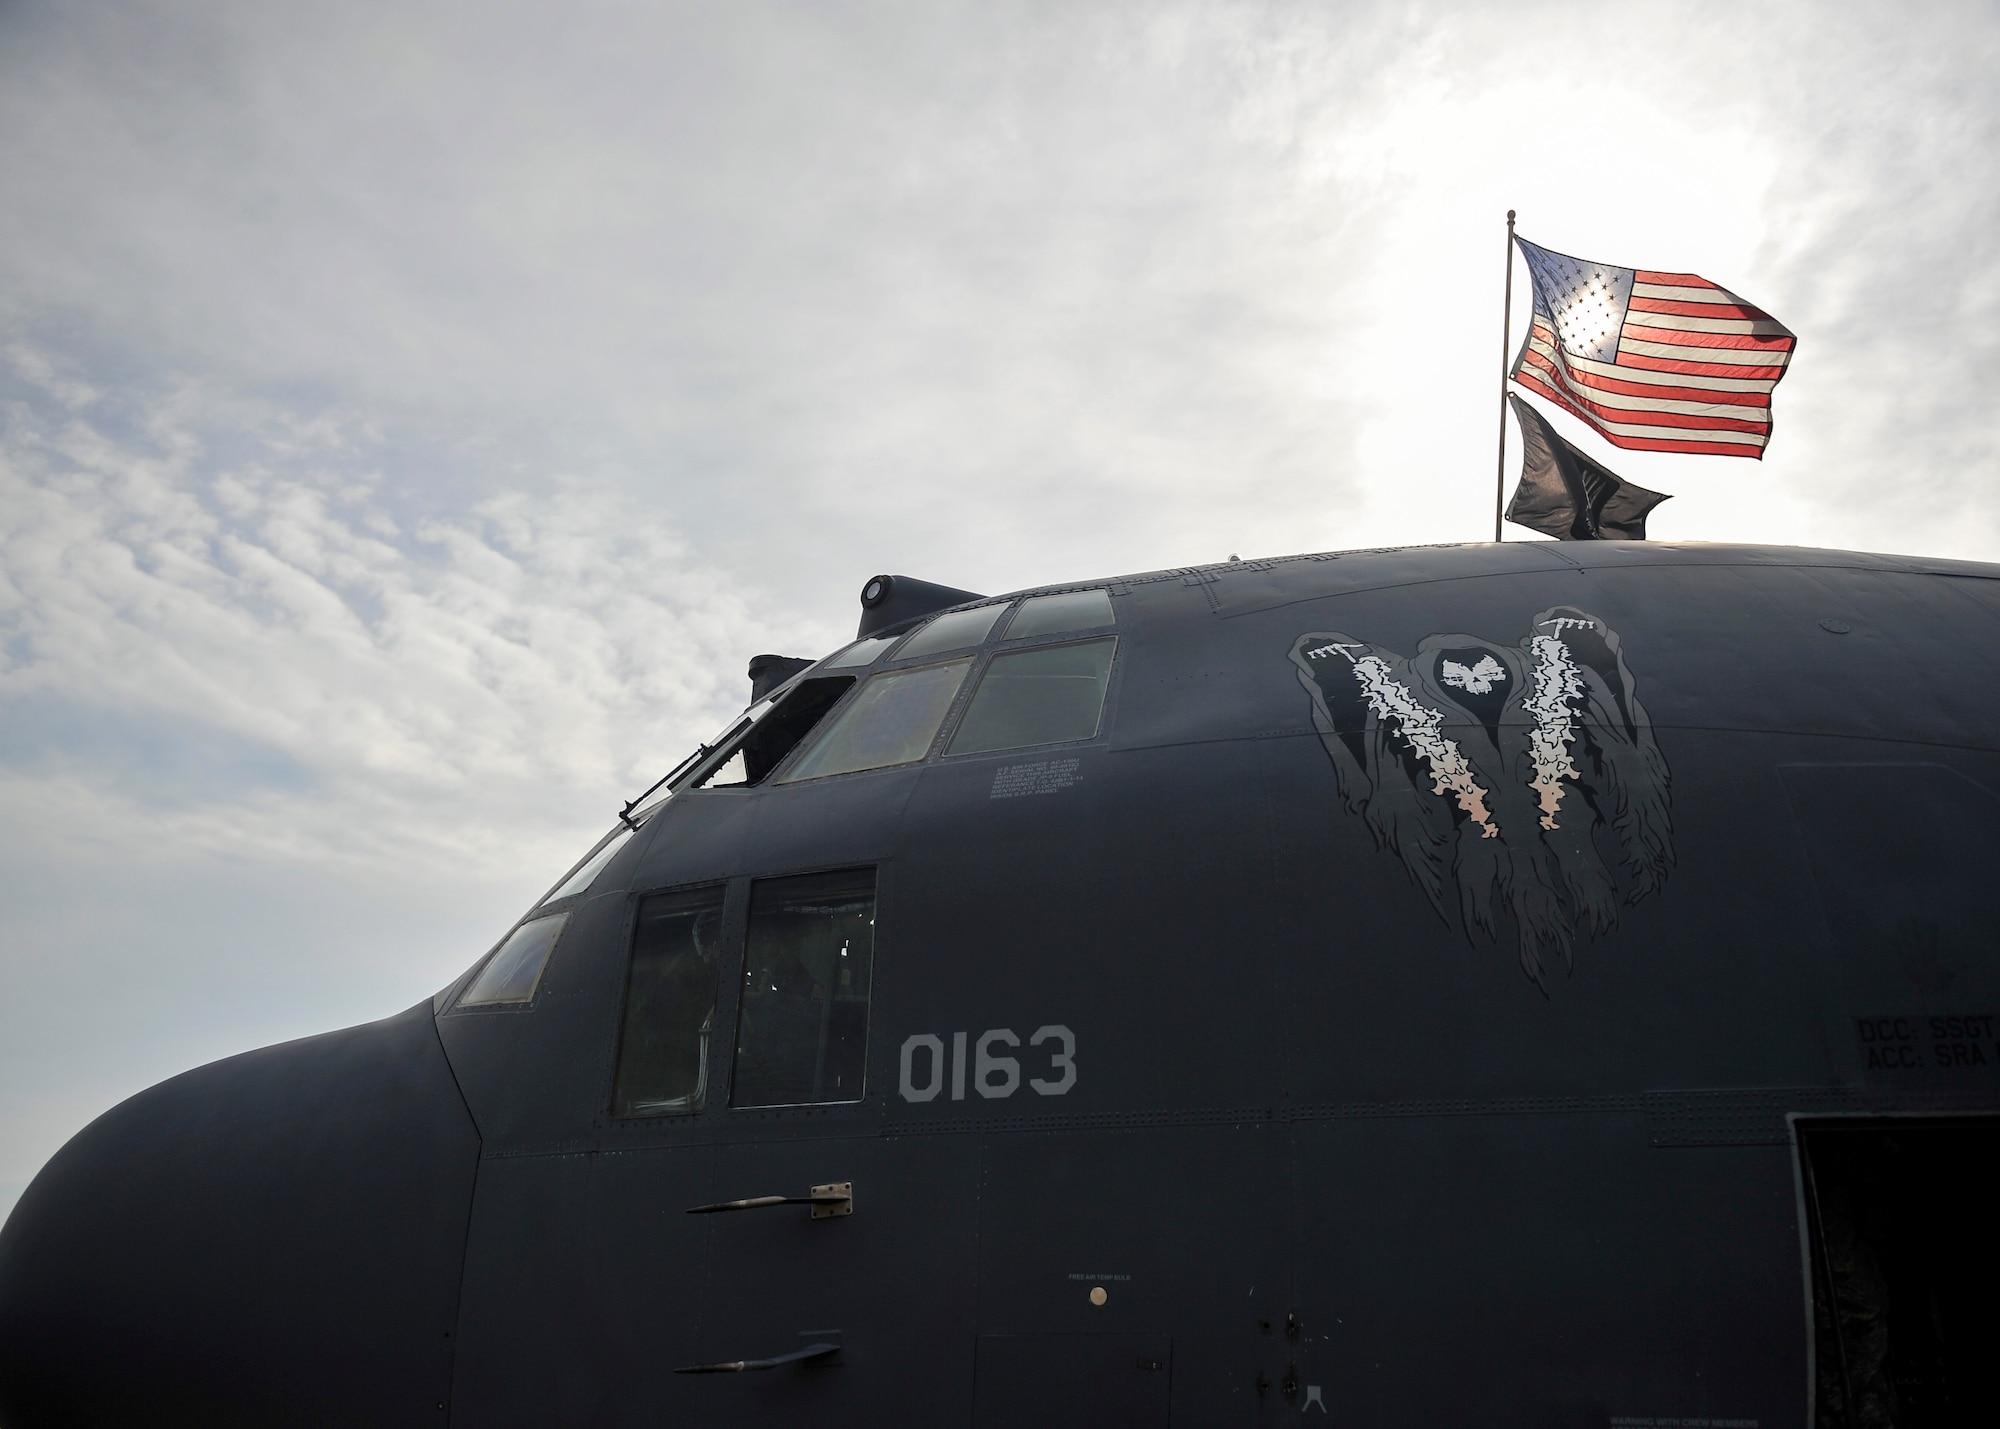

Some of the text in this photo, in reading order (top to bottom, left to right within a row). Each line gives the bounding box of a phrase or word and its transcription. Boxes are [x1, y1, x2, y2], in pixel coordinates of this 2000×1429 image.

[1024, 761, 1048, 769] FORCE
[991, 781, 1074, 794] IDENTIPLATE LOCATION
[1858, 1015, 1992, 1042] DCC: SSGT
[1868, 1045, 1923, 1069] ACC:
[1935, 1042, 1987, 1067] SRA
[899, 1024, 1077, 1103] 0163
[1068, 1273, 1085, 1281] FREE
[1096, 1273, 1113, 1281] TEMP
[1609, 1416, 1654, 1425] WARNING
[1656, 1417, 1680, 1426] WITH
[1681, 1418, 1710, 1427] CREW
[1712, 1418, 1759, 1428] MEMBERS
